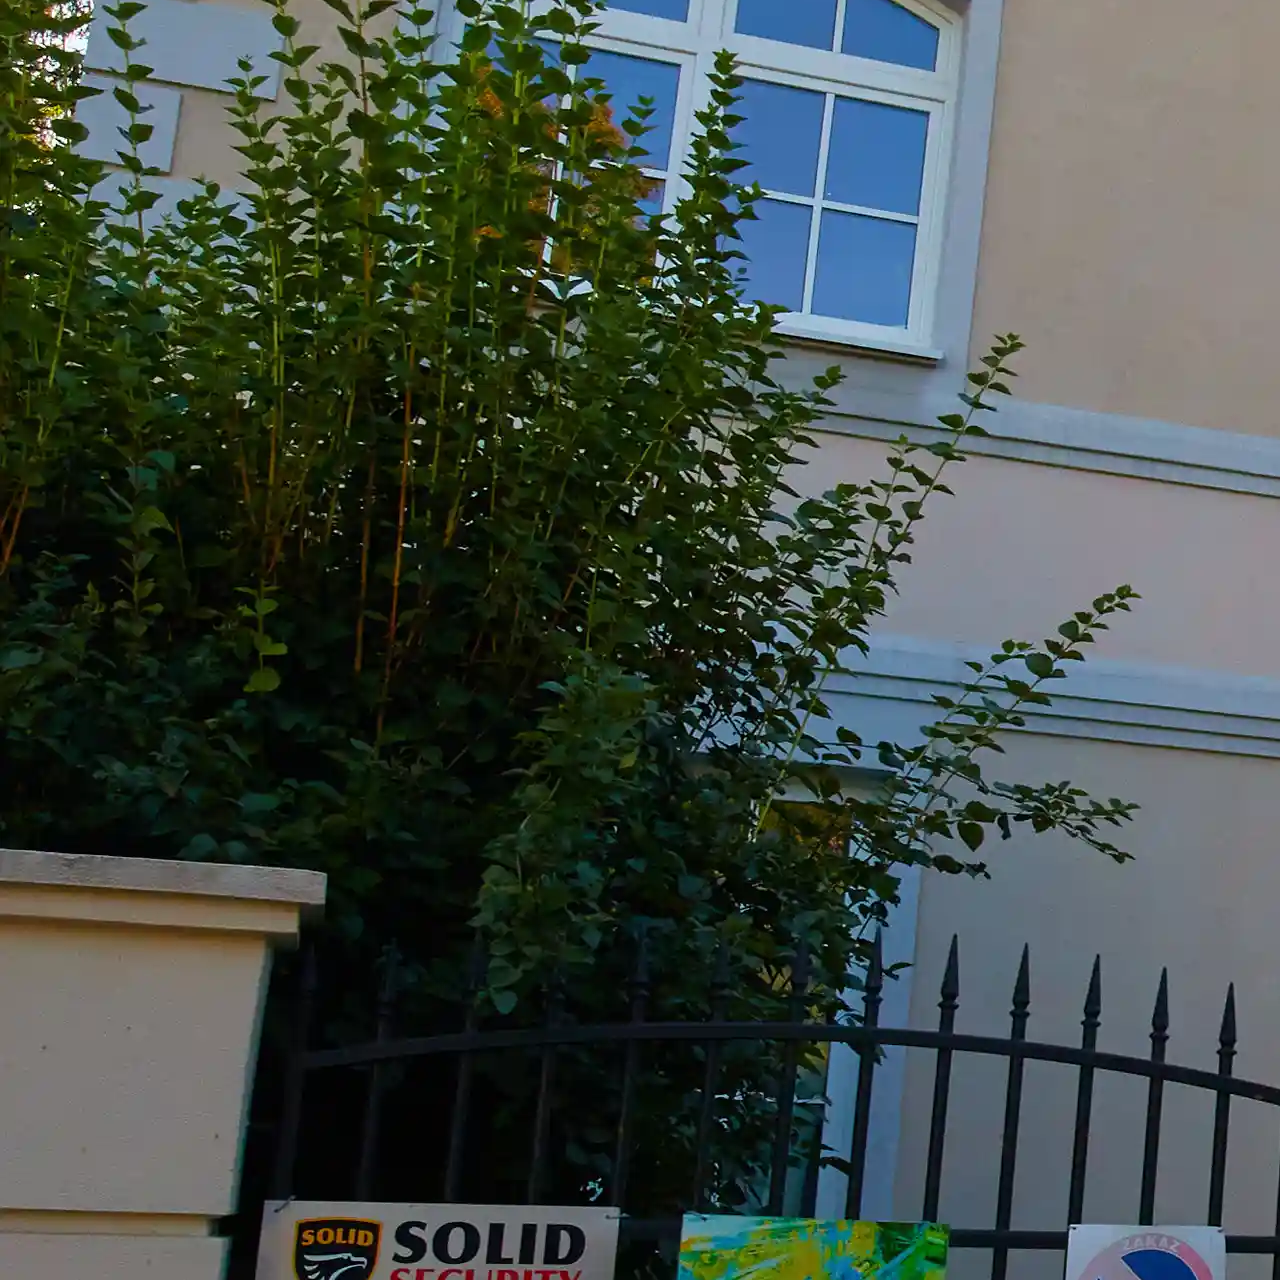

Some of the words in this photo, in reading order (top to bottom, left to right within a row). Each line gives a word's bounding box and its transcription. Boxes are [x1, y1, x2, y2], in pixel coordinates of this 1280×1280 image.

[301, 1227, 374, 1247] SOLID
[392, 1221, 586, 1265] SOLID
[1121, 1234, 1181, 1253] ZAKAZ
